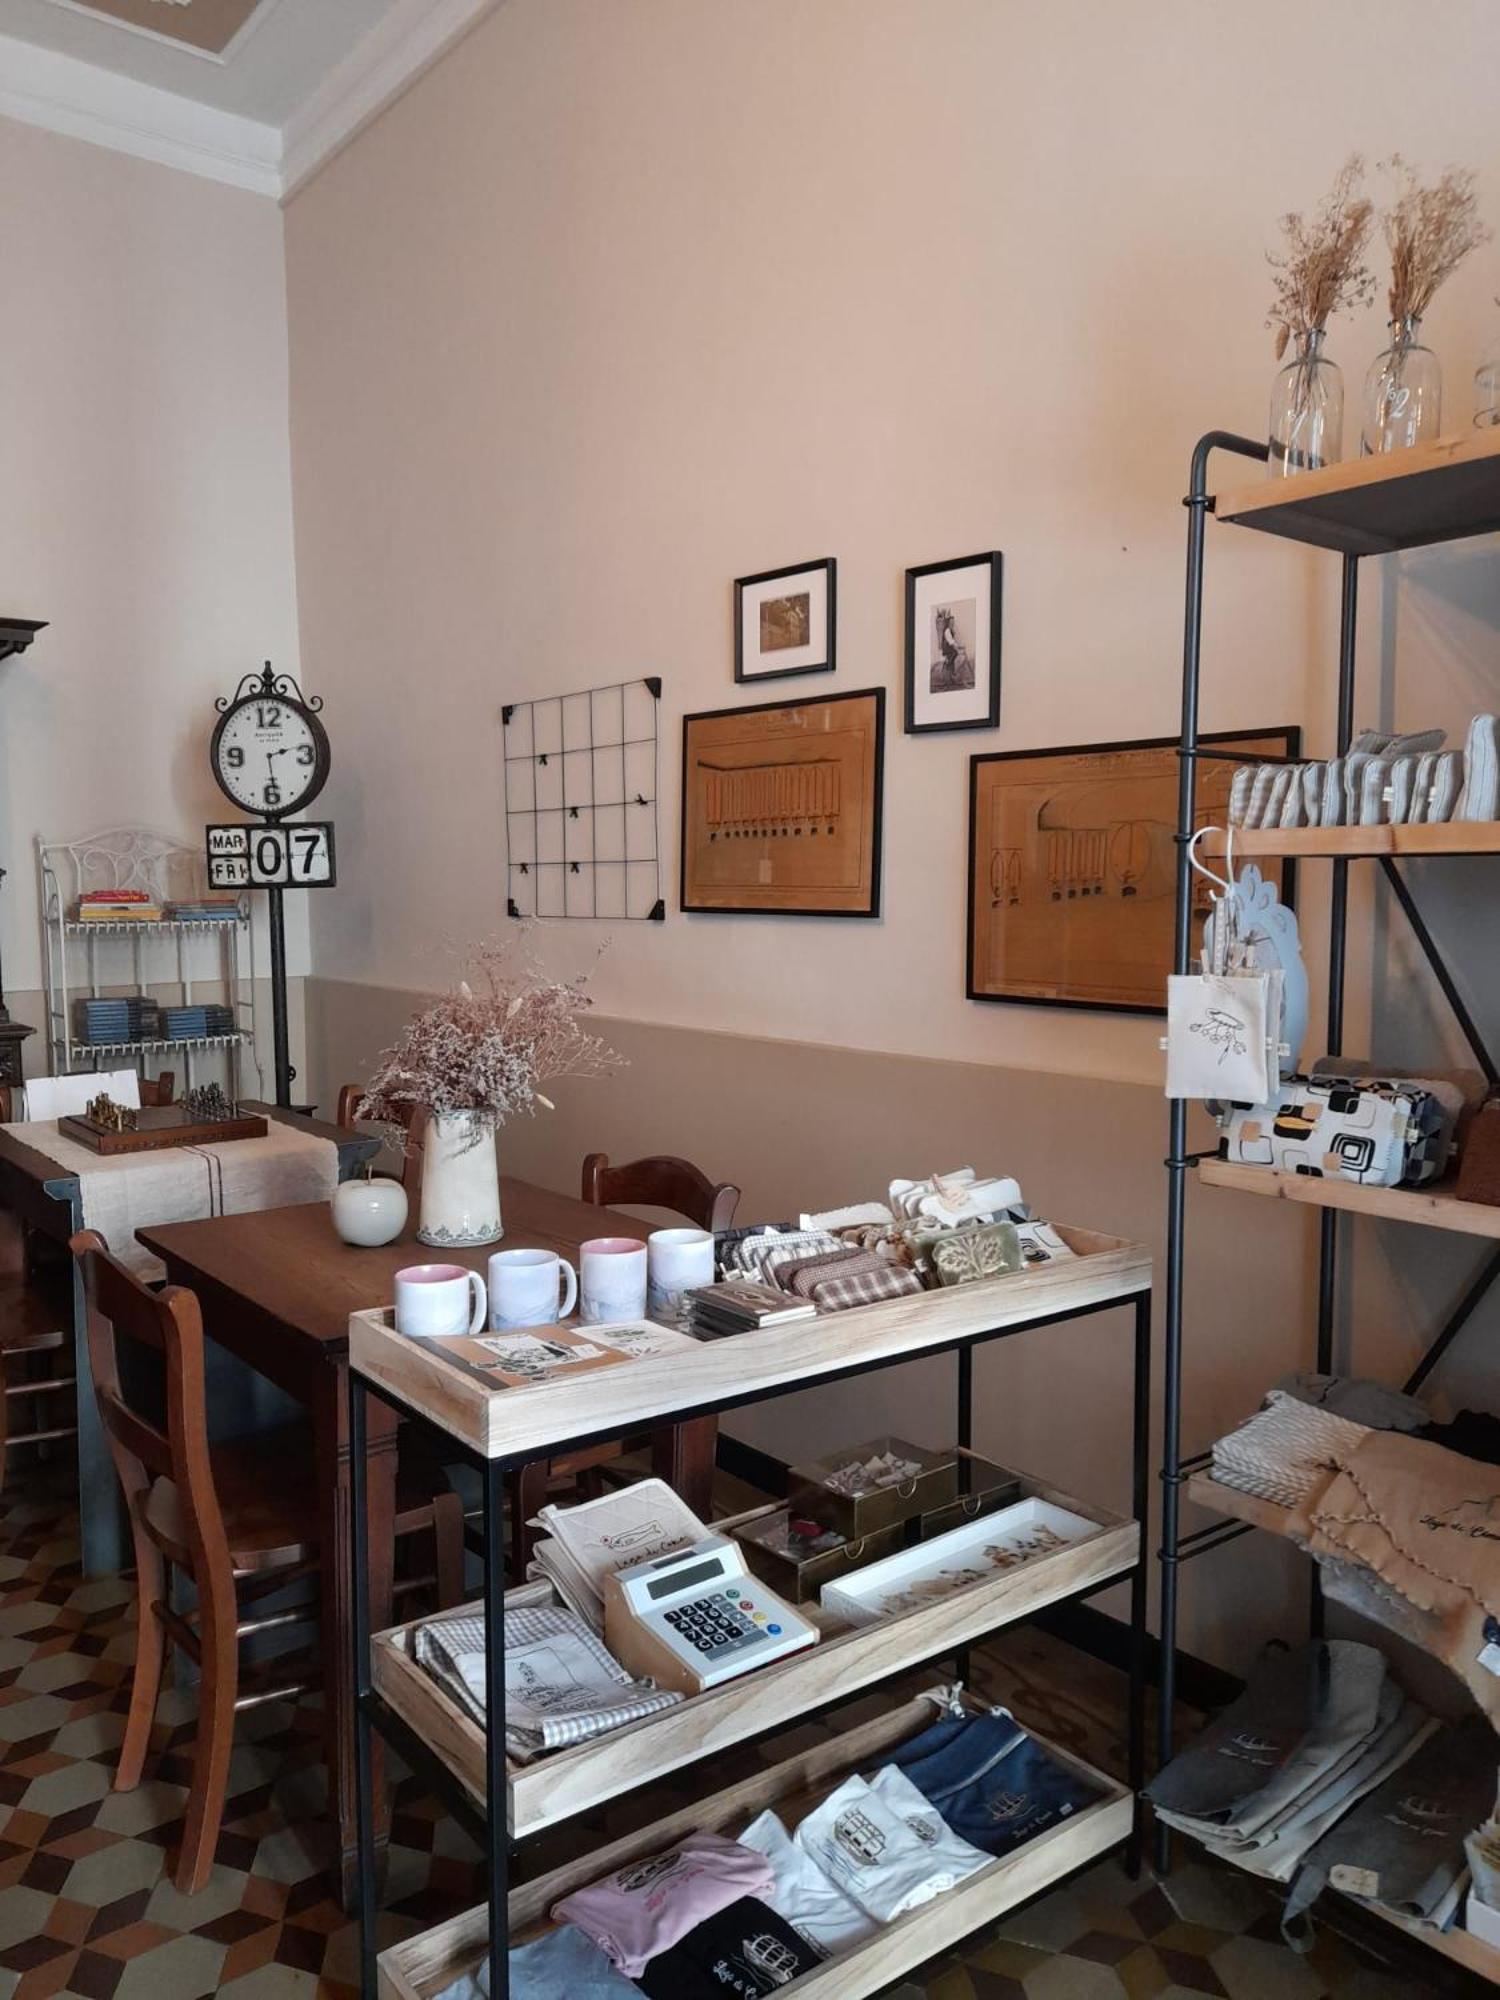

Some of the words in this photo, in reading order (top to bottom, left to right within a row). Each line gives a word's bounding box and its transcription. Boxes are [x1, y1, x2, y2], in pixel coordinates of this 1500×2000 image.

[256, 706, 282, 729] 12
[228, 747, 245, 768] 9
[297, 745, 314, 765] 3
[263, 784, 281, 804] 6
[212, 834, 243, 849] MAR
[215, 864, 245, 879] FRI
